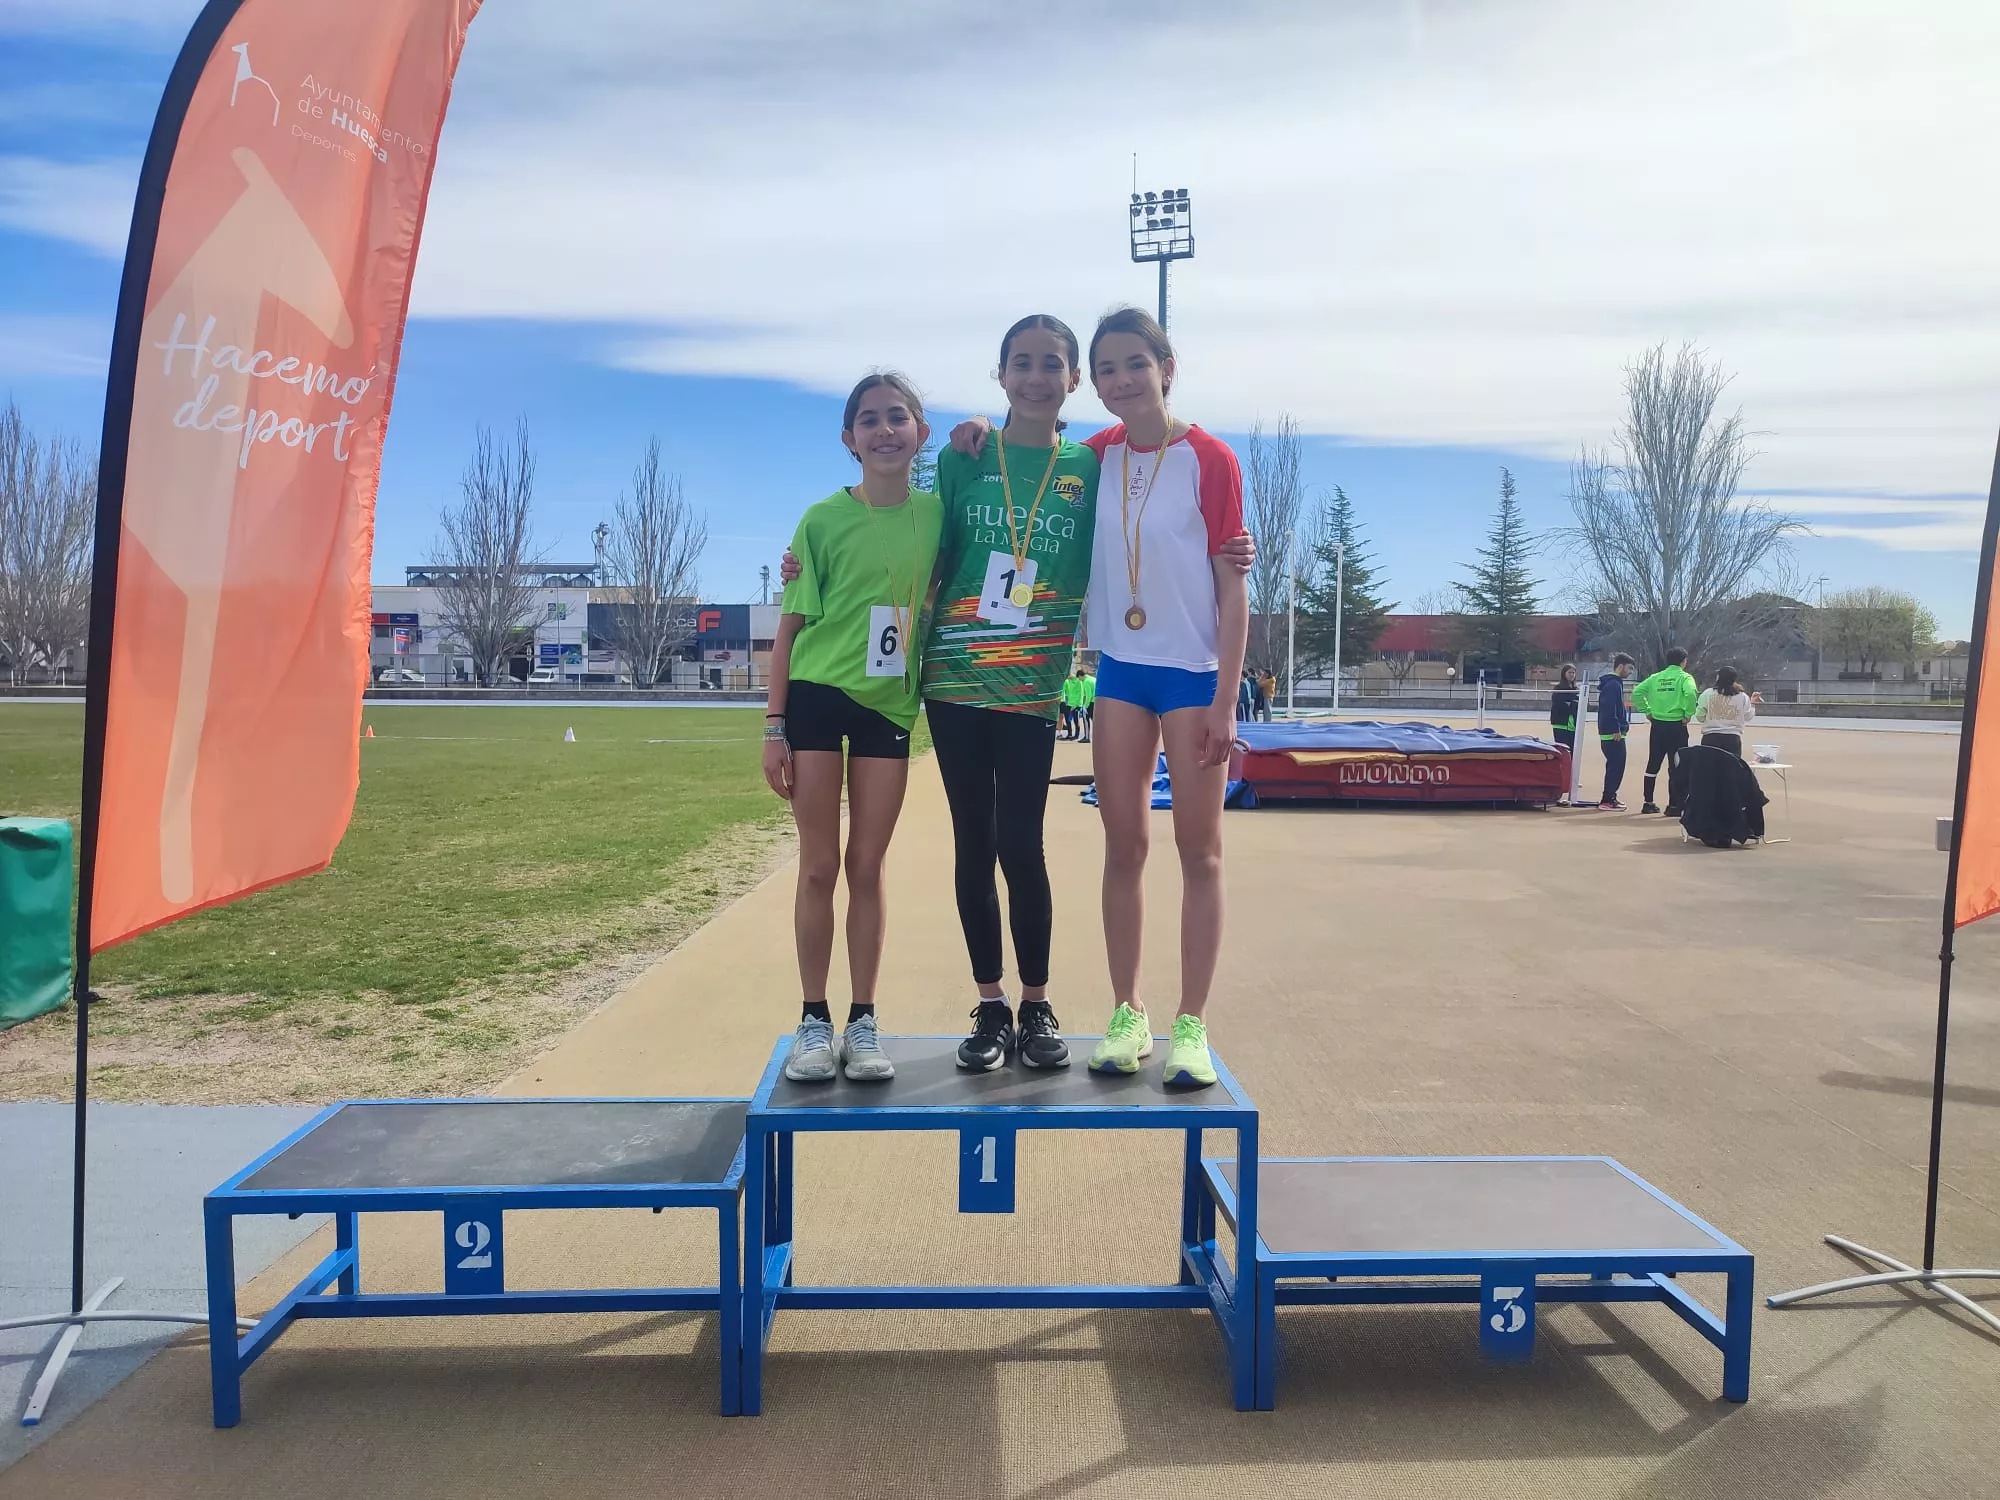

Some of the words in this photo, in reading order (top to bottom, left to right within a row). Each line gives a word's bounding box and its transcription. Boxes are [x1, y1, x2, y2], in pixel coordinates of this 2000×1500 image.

[298, 97, 323, 119] de
[331, 107, 388, 164] Huesca
[300, 73, 424, 154] Ayuntamiento
[291, 124, 358, 162] Deportes
[154, 312, 378, 404] Hacemo
[173, 373, 360, 470] deport
[1000, 569, 1016, 599] 1
[880, 625, 898, 656] 6
[1339, 762, 1450, 785] MONDO
[974, 1136, 998, 1183] 1
[455, 1221, 492, 1269] 2
[1490, 1286, 1526, 1333] 3
